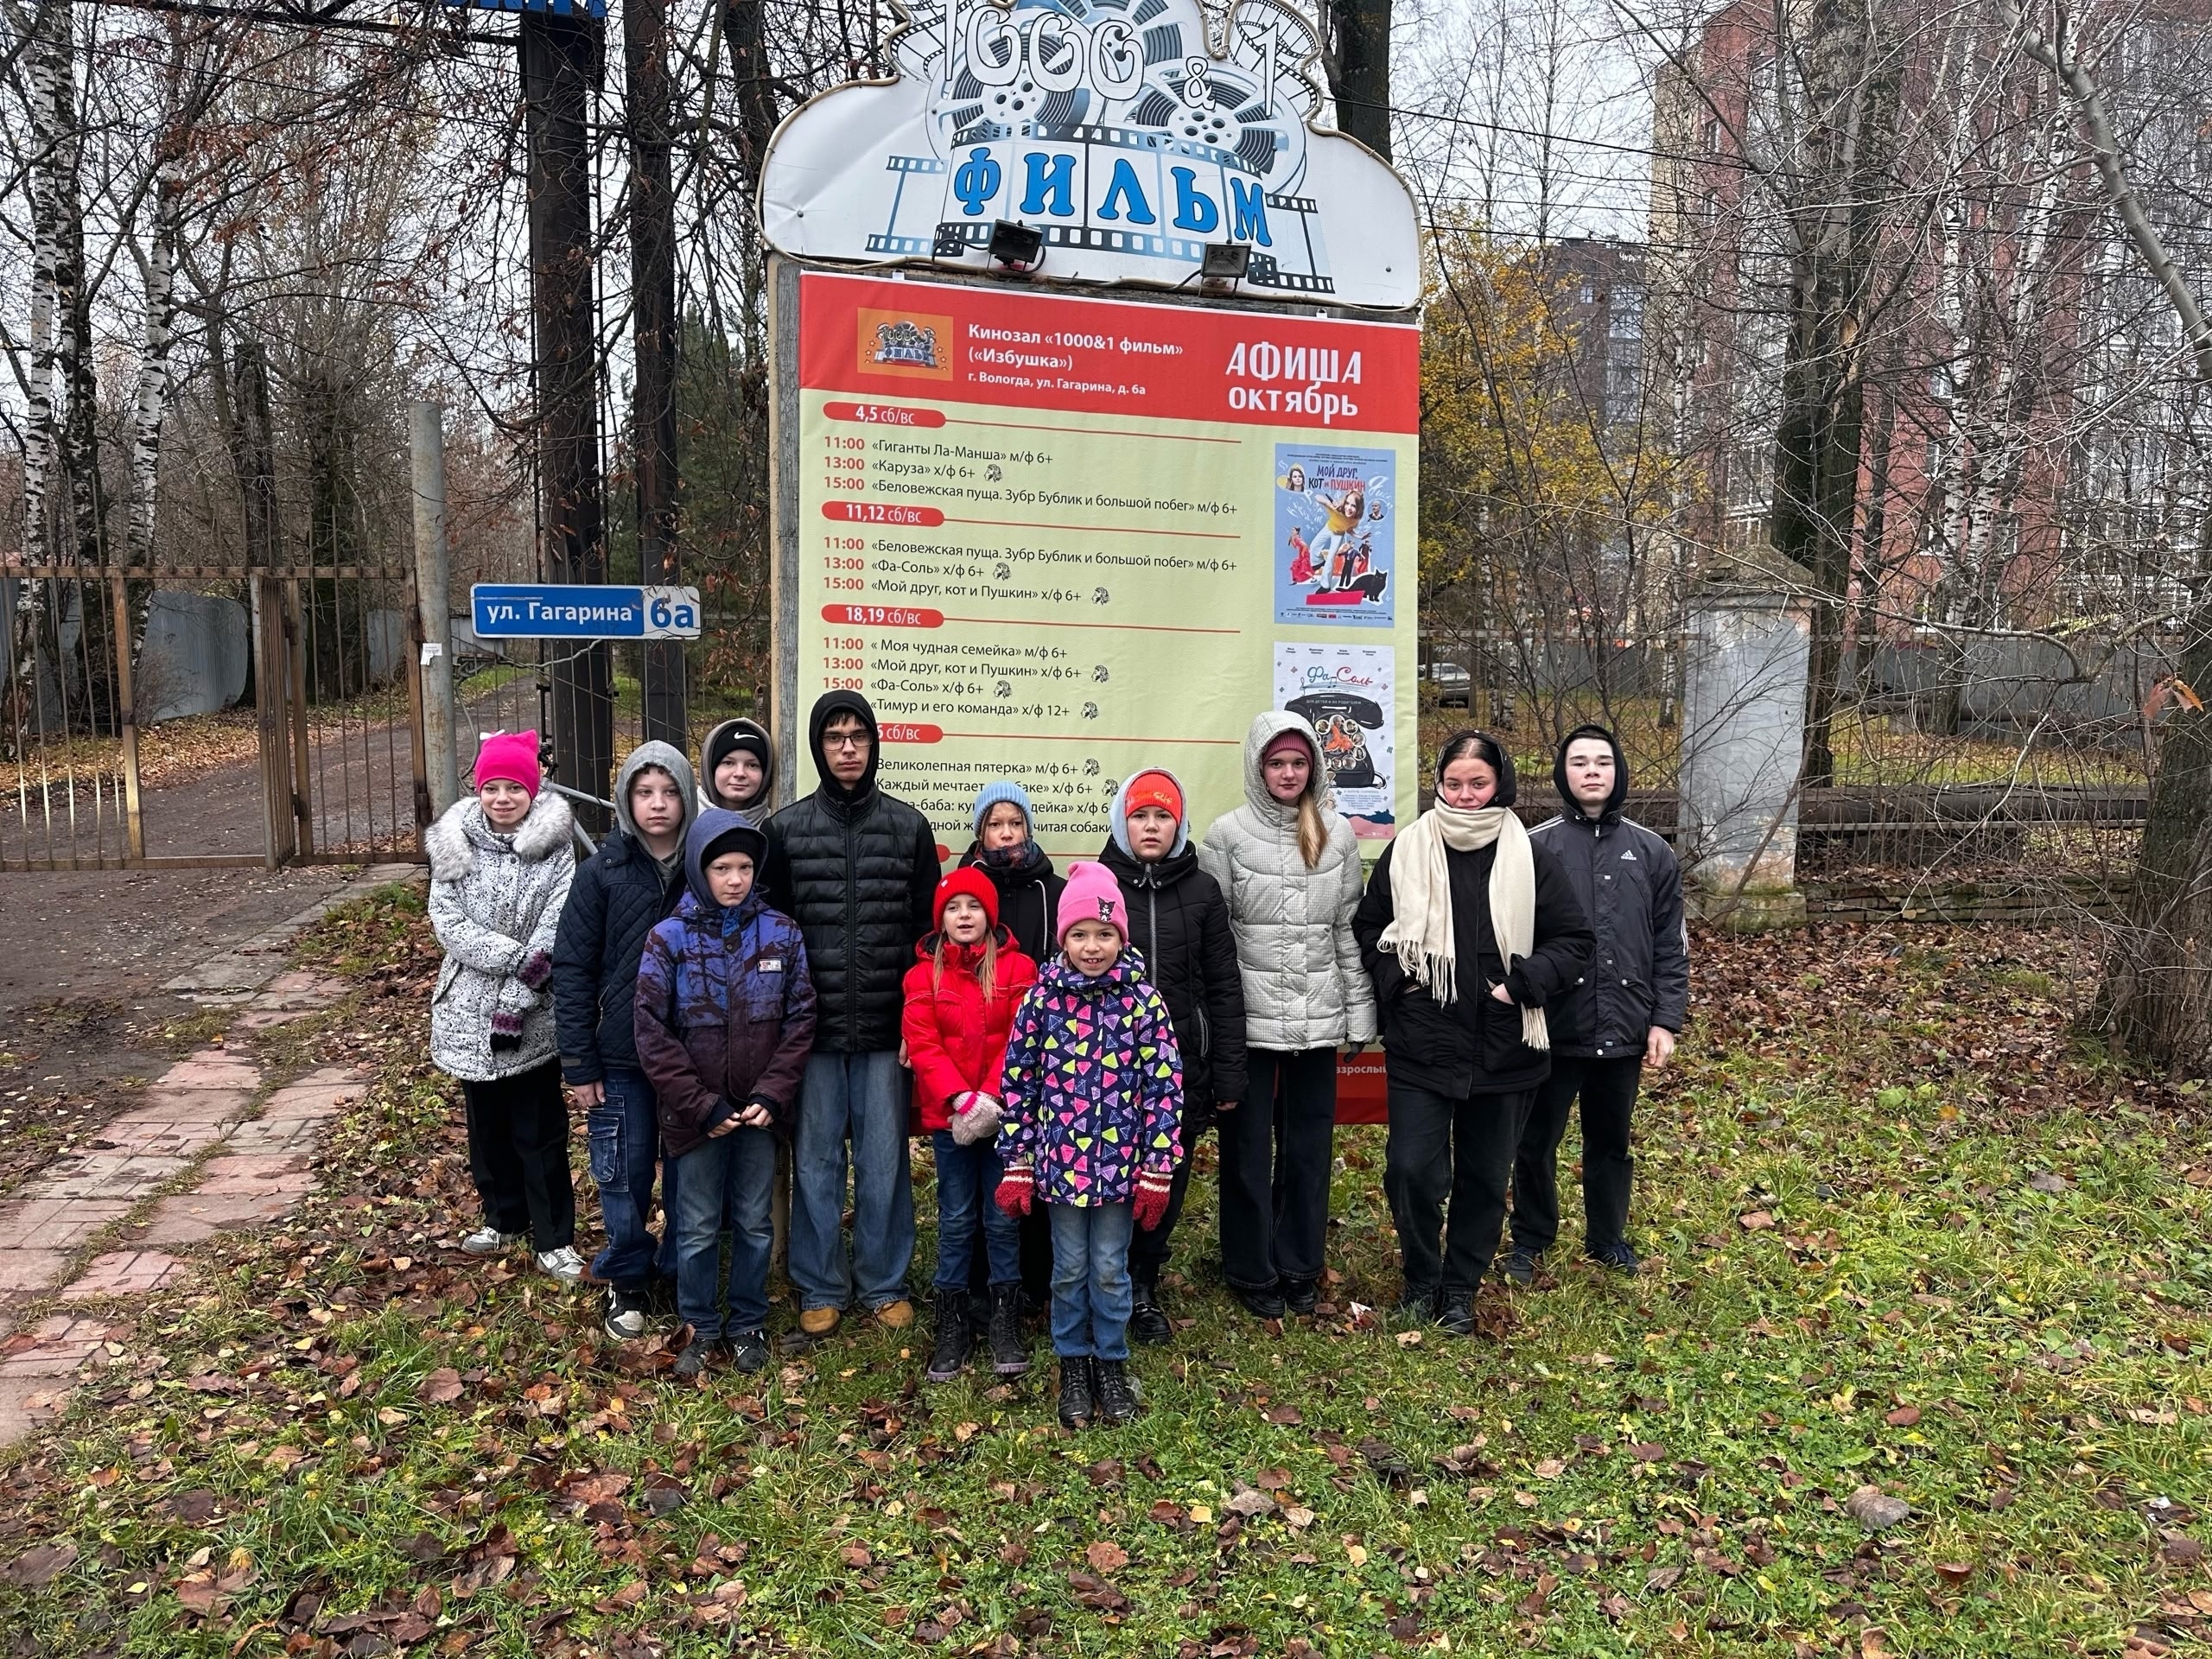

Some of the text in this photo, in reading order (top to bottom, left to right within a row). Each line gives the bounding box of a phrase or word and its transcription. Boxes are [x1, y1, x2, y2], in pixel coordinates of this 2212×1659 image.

[1183, 55, 1216, 111] &
[1252, 22, 1281, 117] 1
[954, 147, 1273, 247] ФИЛЬМ
[969, 324, 1183, 355] Кинозал «1000&1 фильм»
[969, 346, 1073, 371] («Избушка»)
[1225, 341, 1361, 385] АФИША
[968, 372, 1146, 395] г. Вологда, ул. Гагарина, д. 6а
[1229, 381, 1358, 424] октябрь
[855, 405, 914, 424] 4,5 сб/вс
[824, 435, 1052, 465] 11:00 «Гиганты Ла-Манша» м/ф 6+
[824, 456, 976, 479] 13:00 «Каруза» х/ф 6+
[1317, 464, 1358, 480] МОЙ ДРУГ,
[824, 476, 1237, 516] 15:00 «Беловежская пуща. Зубр Бублик и большой побег» м/ф 6+
[1308, 478, 1325, 489] КОТ
[1331, 479, 1366, 492] ПУШКИН
[846, 504, 922, 523] 11,12 сб/вс
[823, 537, 864, 550] 11:00
[872, 539, 963, 556] «Беловежская
[966, 548, 1002, 561] пуща.
[1005, 548, 1035, 563] Зубр
[1039, 550, 1081, 563] Бублик
[1096, 552, 1151, 566] большой
[1154, 556, 1194, 569] побег»
[1197, 559, 1218, 572] м/ф
[1222, 560, 1236, 571] 6+
[823, 556, 984, 578] 13:00 «Фа-Соль» х/ф 6+
[823, 576, 1081, 603] 15:00 «Мой друг, кот и Пушкин» х/ф 6+
[486, 597, 695, 628] ул. Гагарина 6а
[846, 607, 921, 625] 18,19 сб/вс
[823, 637, 864, 650] 11:00
[880, 639, 909, 652] Моя
[912, 642, 958, 655] чудная
[962, 645, 1021, 657] семейка»
[1025, 646, 1048, 660] м/ф
[1051, 647, 1067, 658] 6+
[823, 657, 1081, 680] 13:00 «Мой друг, кот и Пушкин» х/ф 6+
[823, 677, 983, 695] 15:00 «Фа-Соль» х/ф 6+
[870, 698, 1070, 718] «Тимур и его команда» х/ф 12+
[887, 724, 920, 741] сб/вс
[877, 758, 1078, 776] Великолепная пятерка» м/ф 6+
[876, 779, 929, 791] Каждый
[933, 782, 985, 792] мечтает
[1052, 782, 1073, 796] х/ф
[1077, 783, 1092, 793] 6+
[1031, 802, 1074, 814] дейка»
[1077, 802, 1098, 816] х/ф
[929, 819, 961, 832] дной
[1033, 823, 1067, 832] читая
[1070, 821, 1112, 833] собаки
